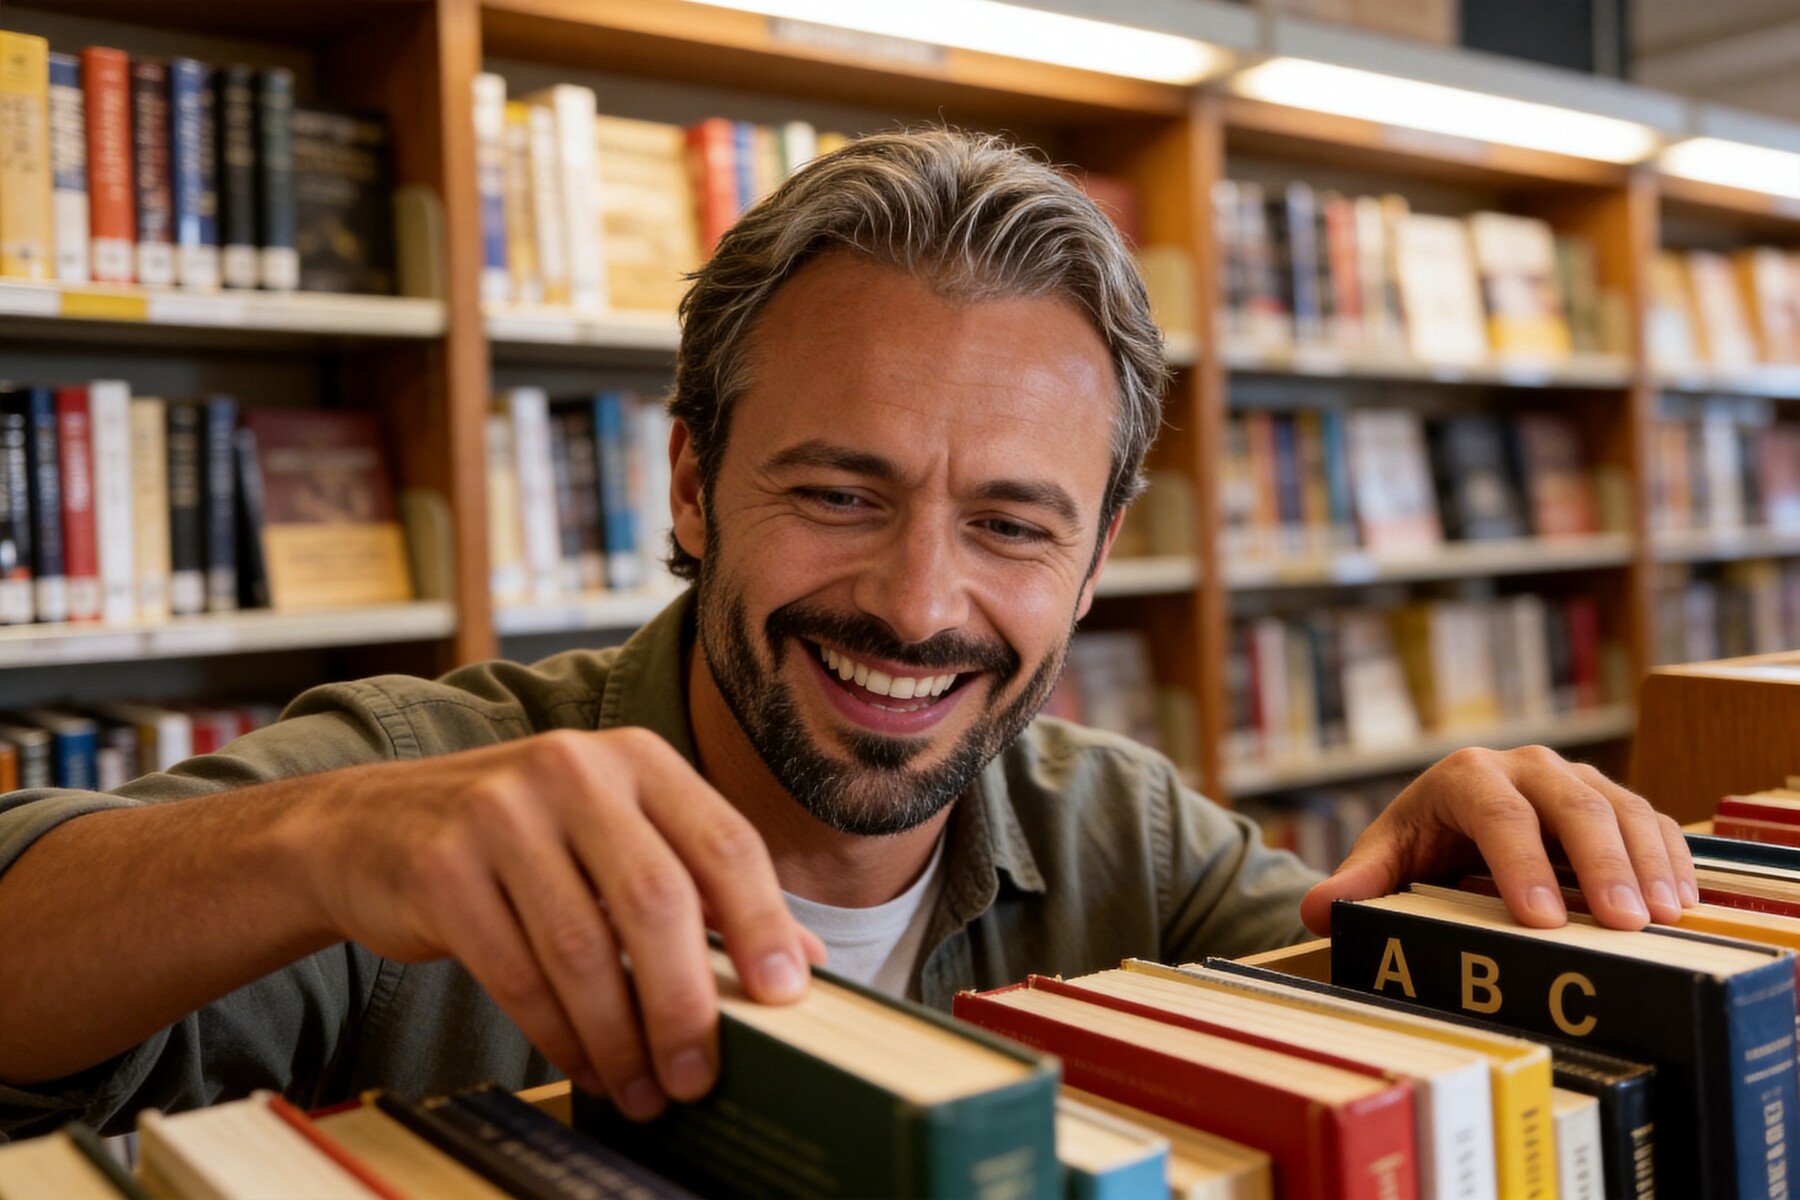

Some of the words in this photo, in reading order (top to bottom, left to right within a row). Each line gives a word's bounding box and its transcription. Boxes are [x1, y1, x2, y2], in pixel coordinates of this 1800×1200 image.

[1373, 937, 1417, 998] A
[1461, 951, 1503, 1014] B
[1548, 972, 1598, 1036] C
